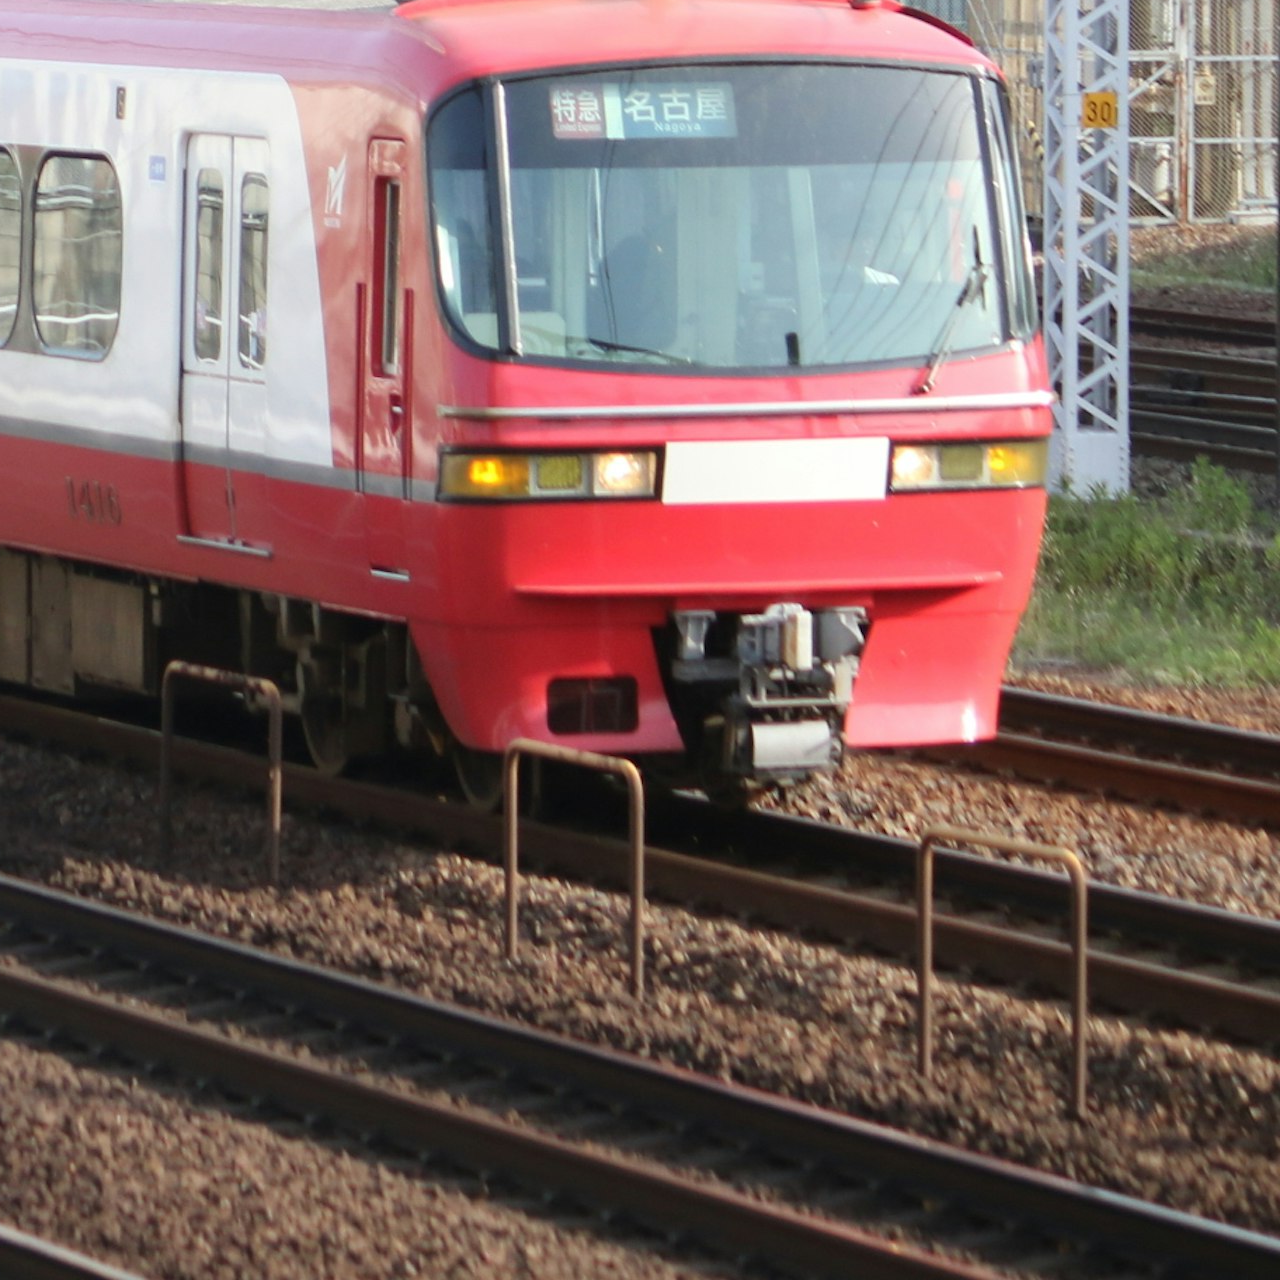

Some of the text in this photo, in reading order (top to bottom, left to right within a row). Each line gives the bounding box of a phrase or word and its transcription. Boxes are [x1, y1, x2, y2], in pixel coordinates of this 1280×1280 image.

[552, 89, 601, 122] 特急
[624, 88, 727, 122] 名古屋
[1086, 100, 1112, 123] 30
[653, 121, 702, 133] Nagoya
